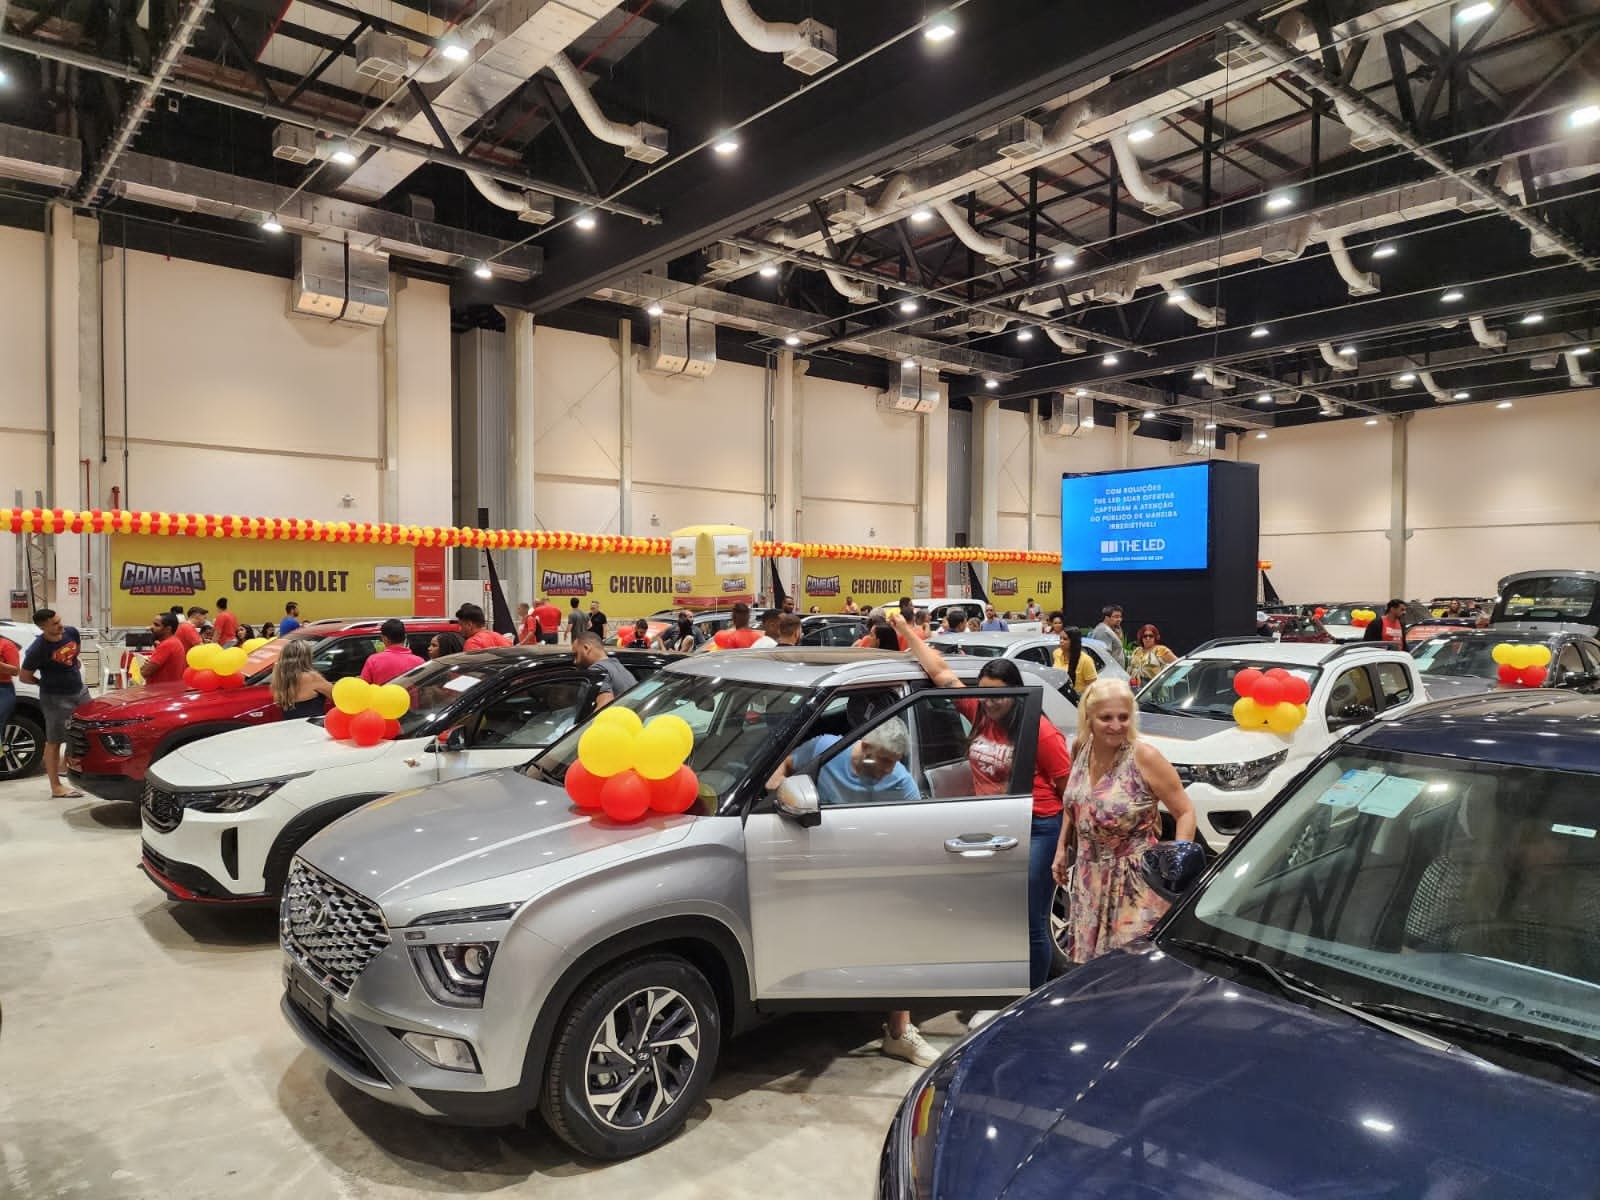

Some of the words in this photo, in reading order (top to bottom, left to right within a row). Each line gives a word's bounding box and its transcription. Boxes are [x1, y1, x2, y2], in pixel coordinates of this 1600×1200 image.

[1142, 492, 1175, 501] OFERTAS
[1094, 504, 1132, 513] CAPTURAM
[1140, 501, 1174, 511] ATENÇÃO
[1120, 539, 1142, 552] THE
[1142, 538, 1166, 552] LED
[122, 562, 204, 588] COMBATE
[233, 568, 349, 592] CHEVROLET
[542, 570, 592, 589] COMBATE
[806, 576, 840, 591] COMBATE
[851, 578, 902, 594] CHEVROLET
